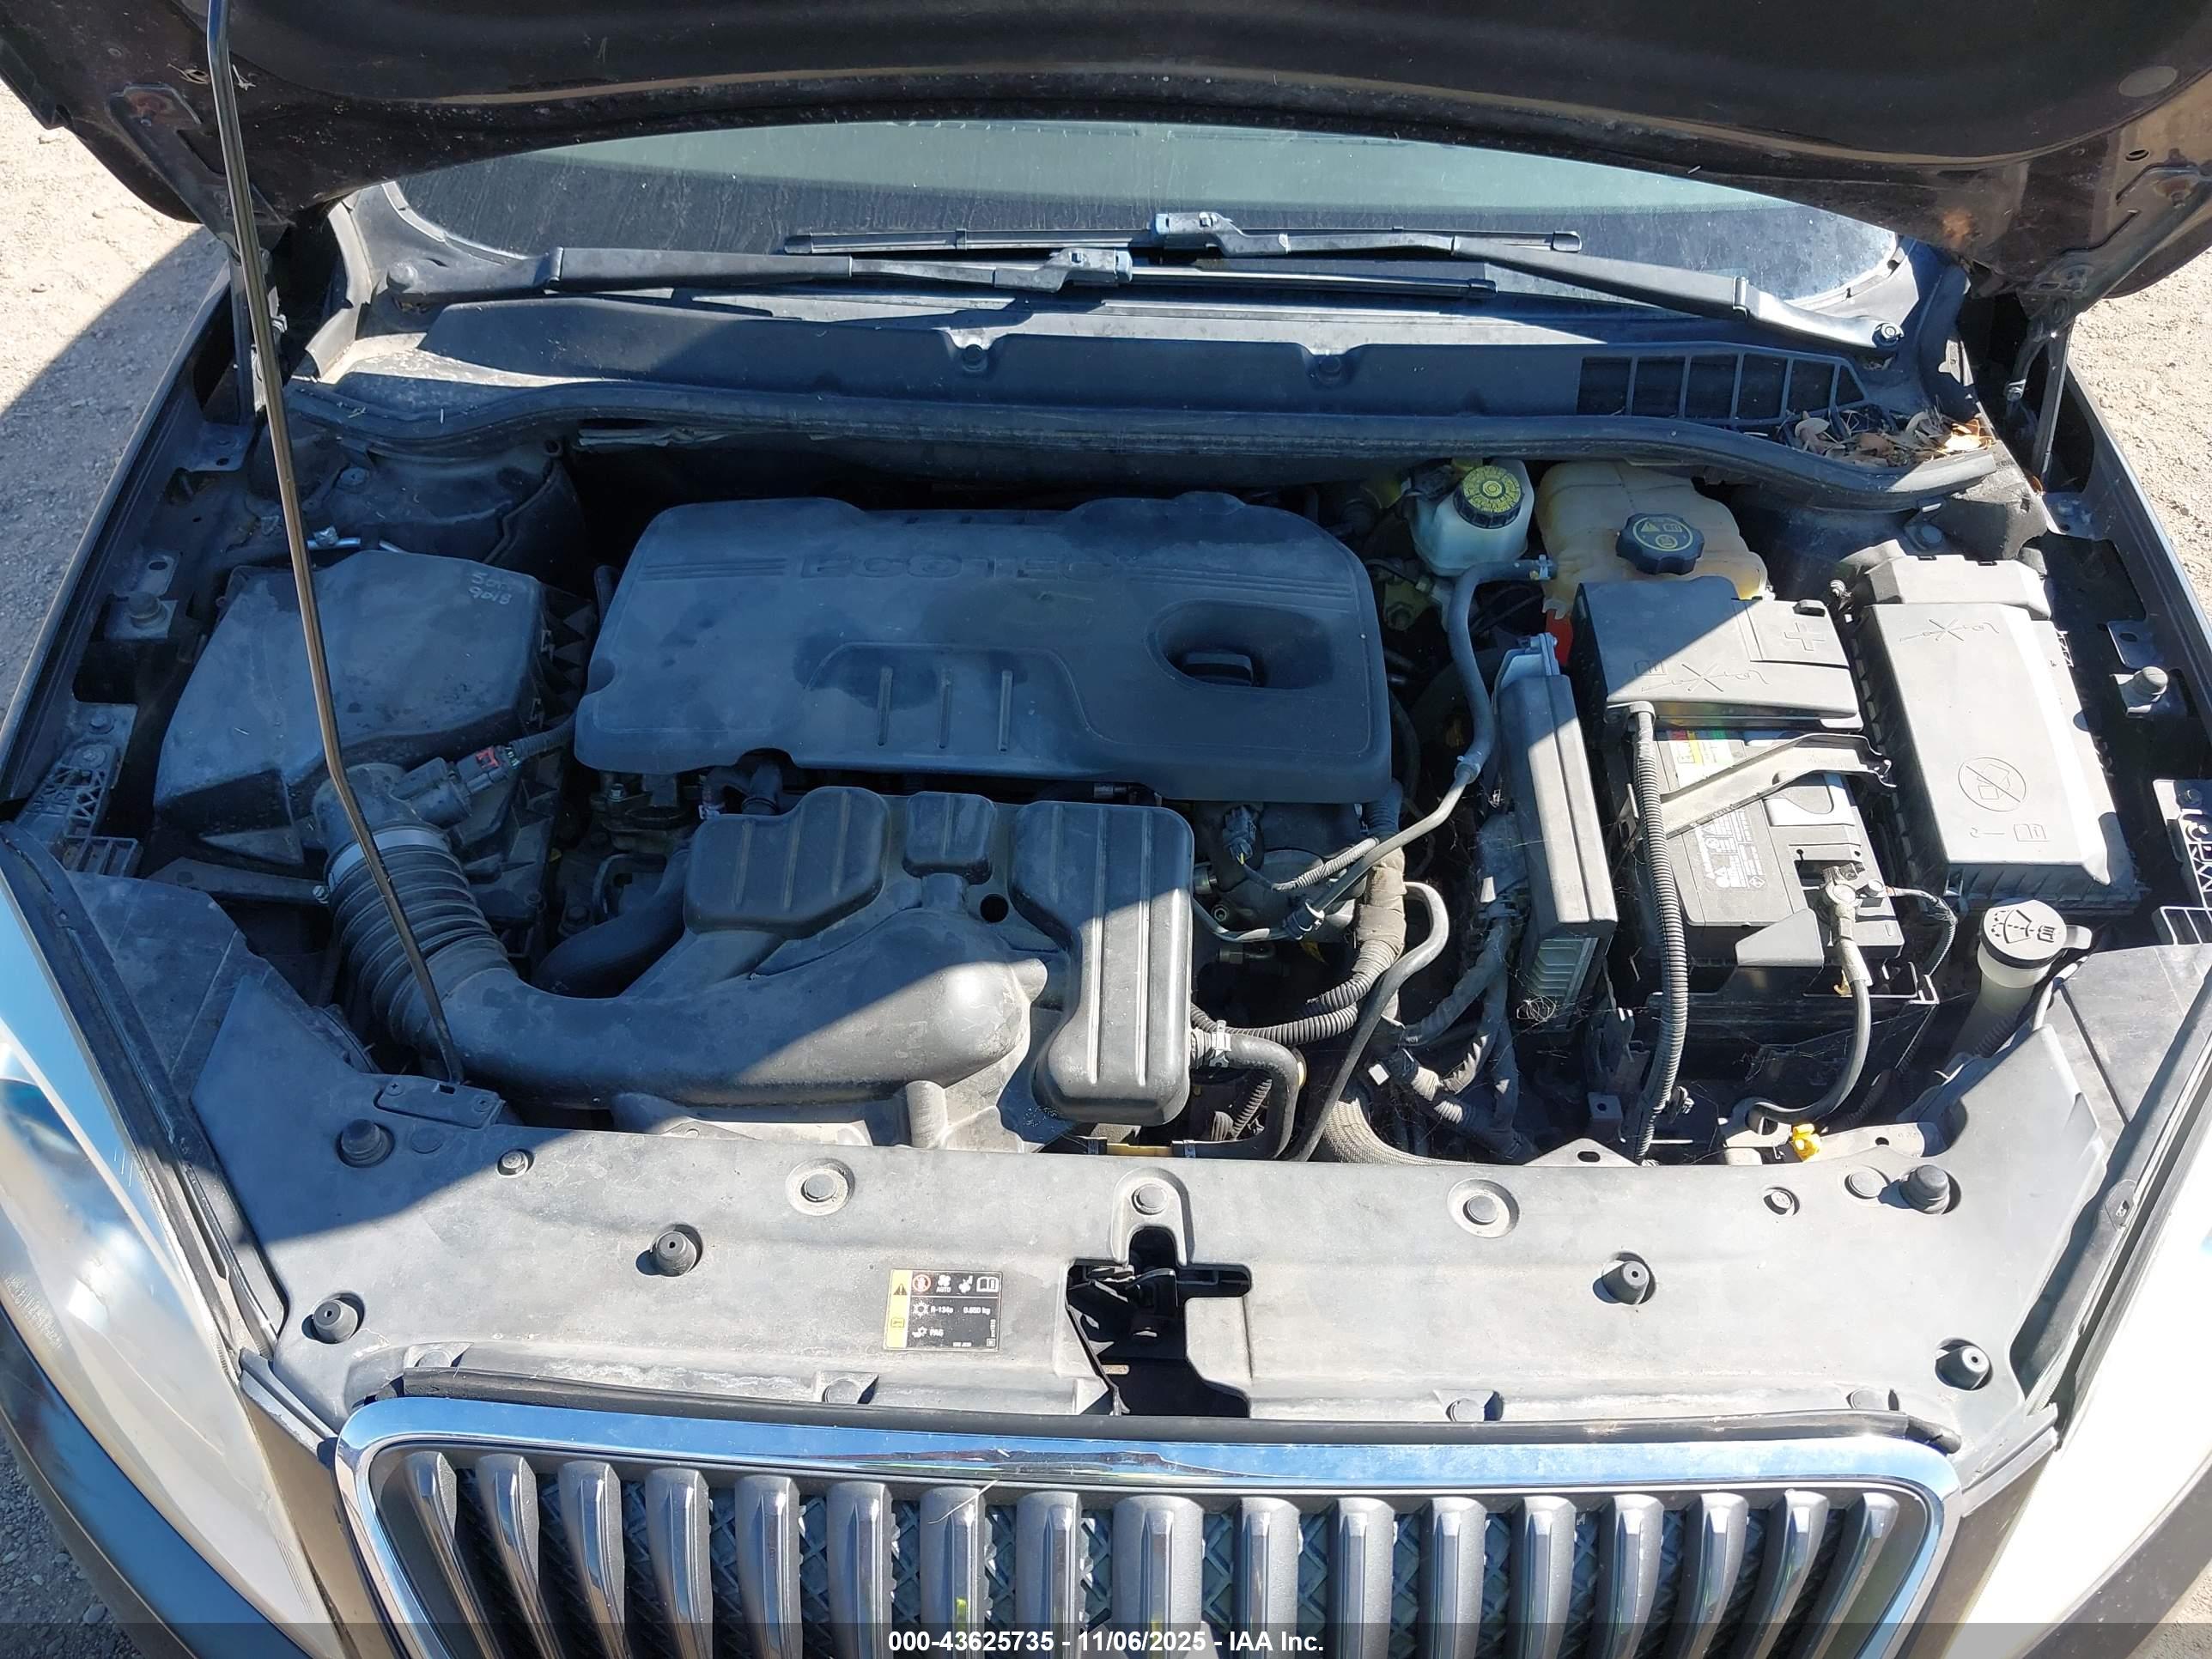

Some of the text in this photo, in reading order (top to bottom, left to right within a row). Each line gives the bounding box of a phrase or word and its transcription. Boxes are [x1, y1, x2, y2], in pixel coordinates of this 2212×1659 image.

[800, 556, 1115, 582] ECOTEC
[930, 1305, 954, 1315] R-134a
[981, 1307, 991, 1316] kg
